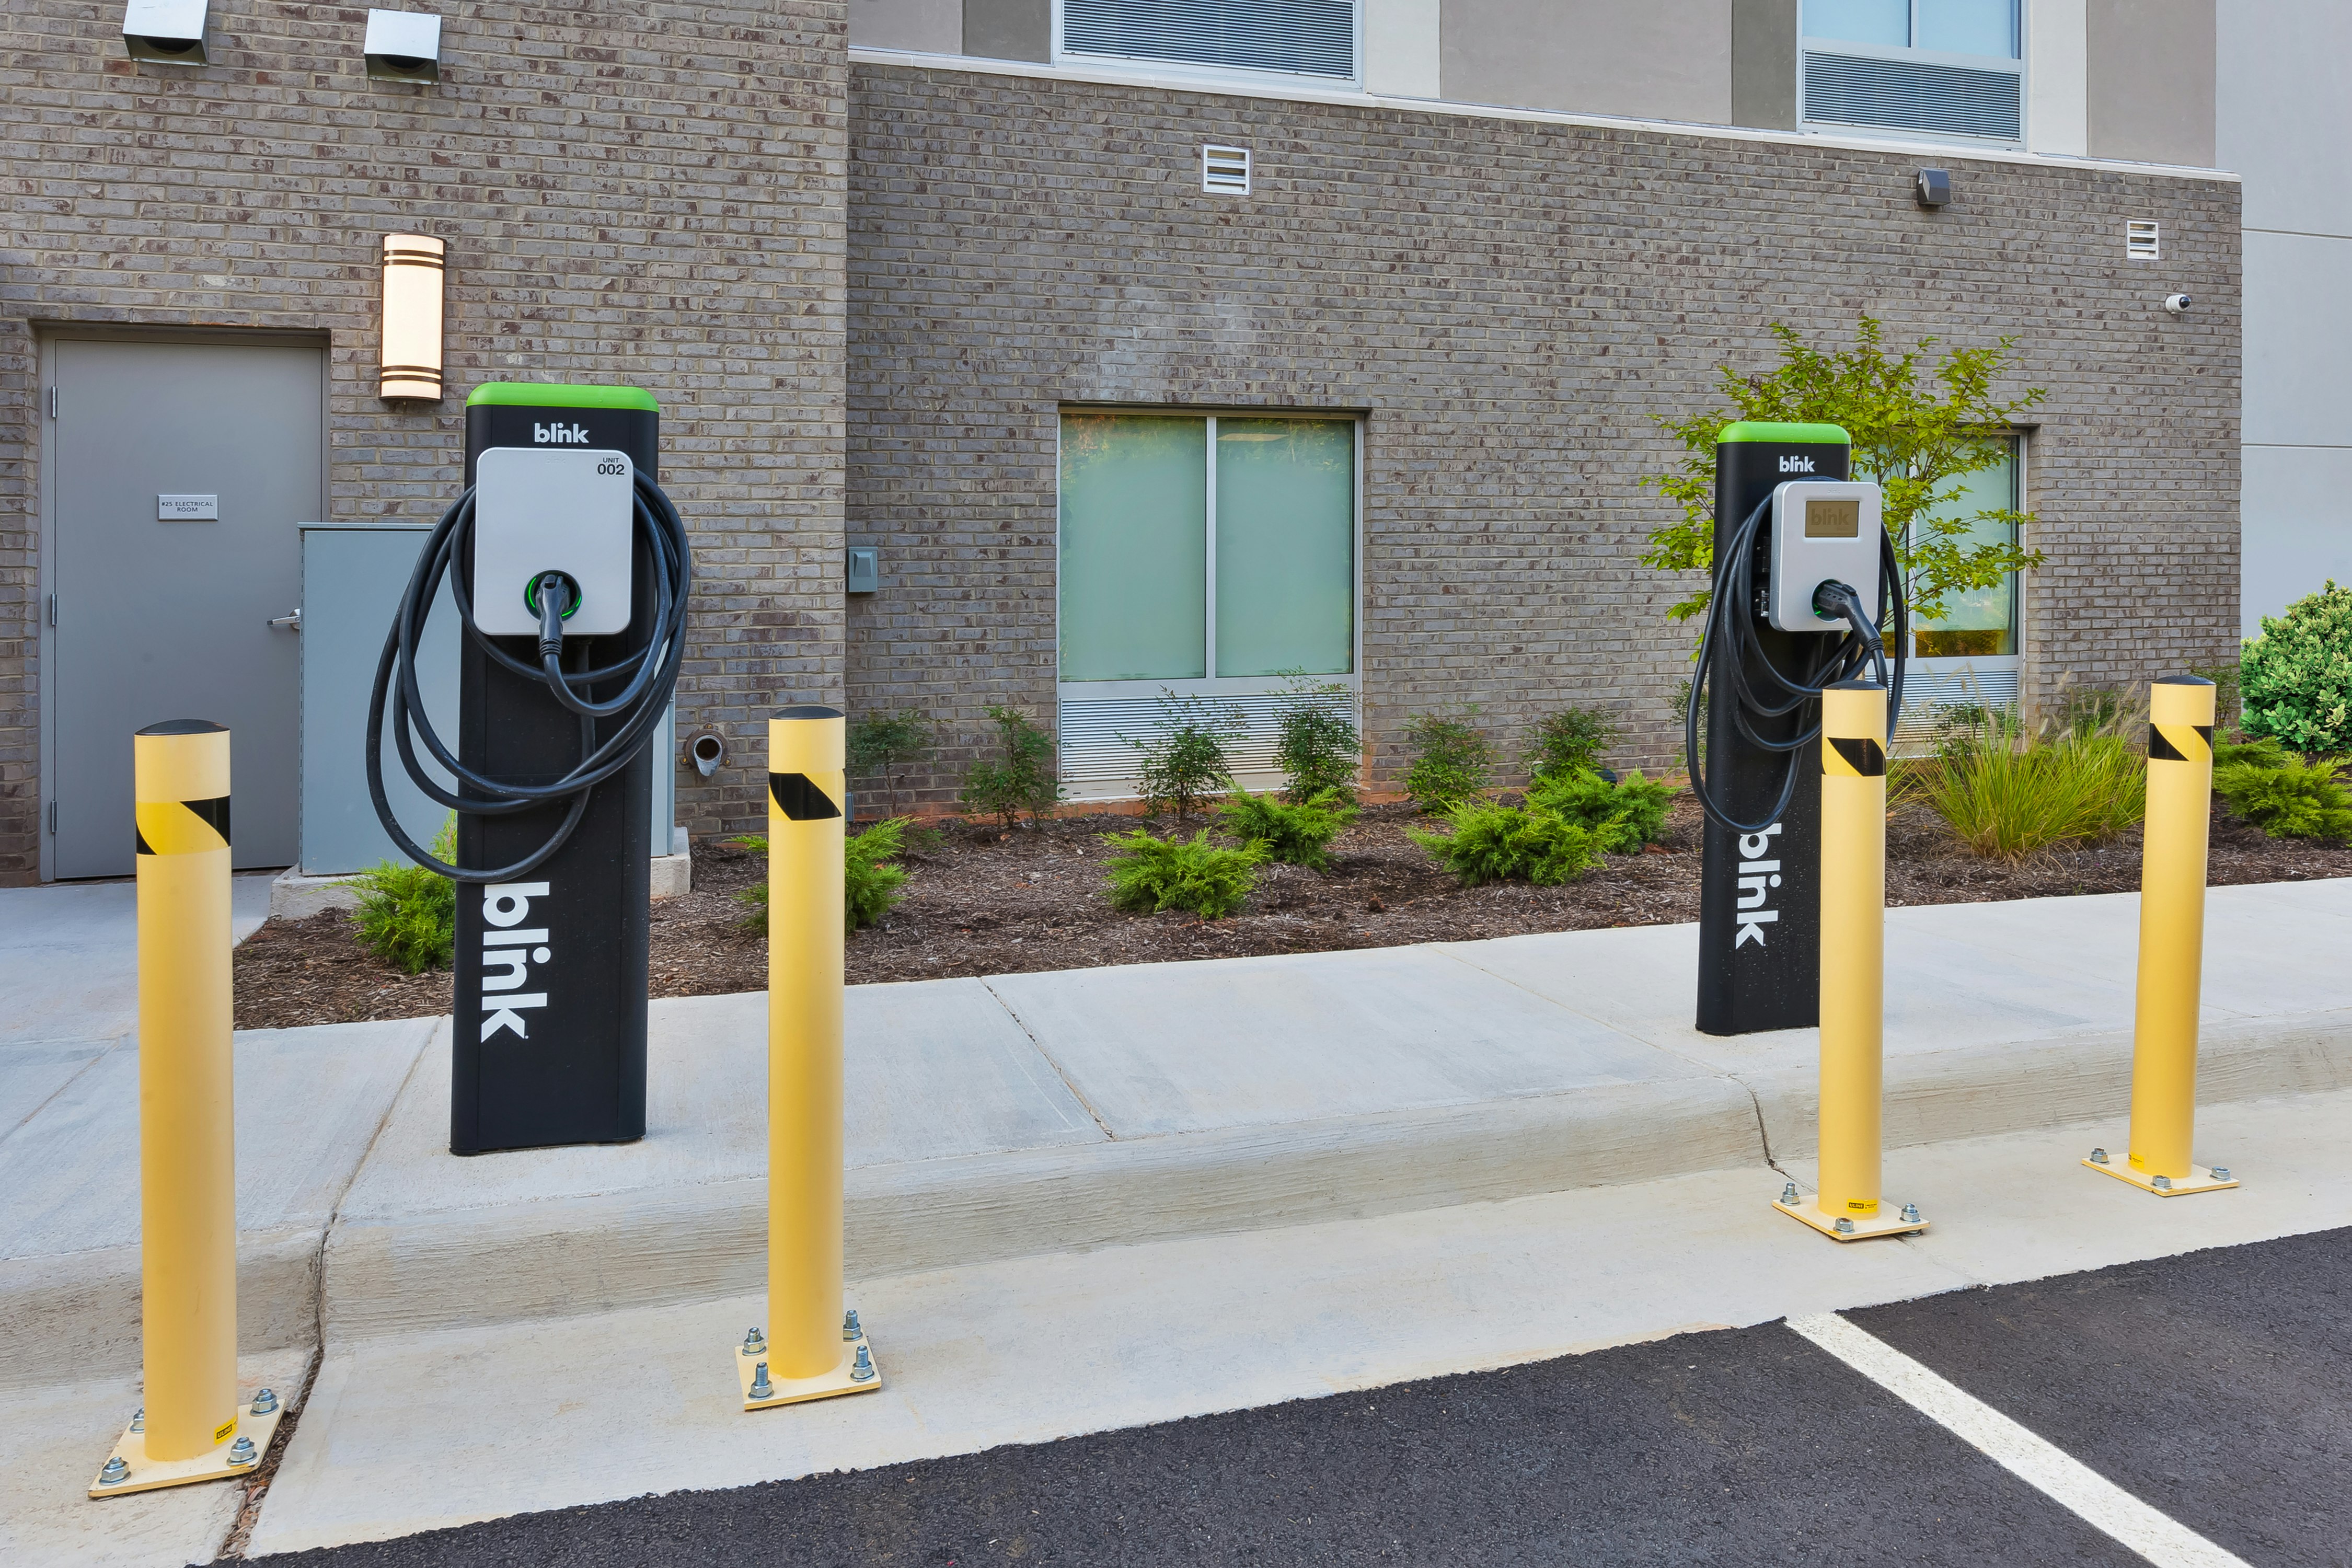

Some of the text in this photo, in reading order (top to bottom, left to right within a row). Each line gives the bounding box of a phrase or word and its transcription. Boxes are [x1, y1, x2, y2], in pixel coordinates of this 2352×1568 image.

[534, 422, 590, 443] blink
[597, 463, 625, 476] 002
[1779, 455, 1815, 472] blink
[1811, 508, 1850, 525] blink
[1735, 823, 1782, 949] blink
[481, 882, 551, 1043] blink
